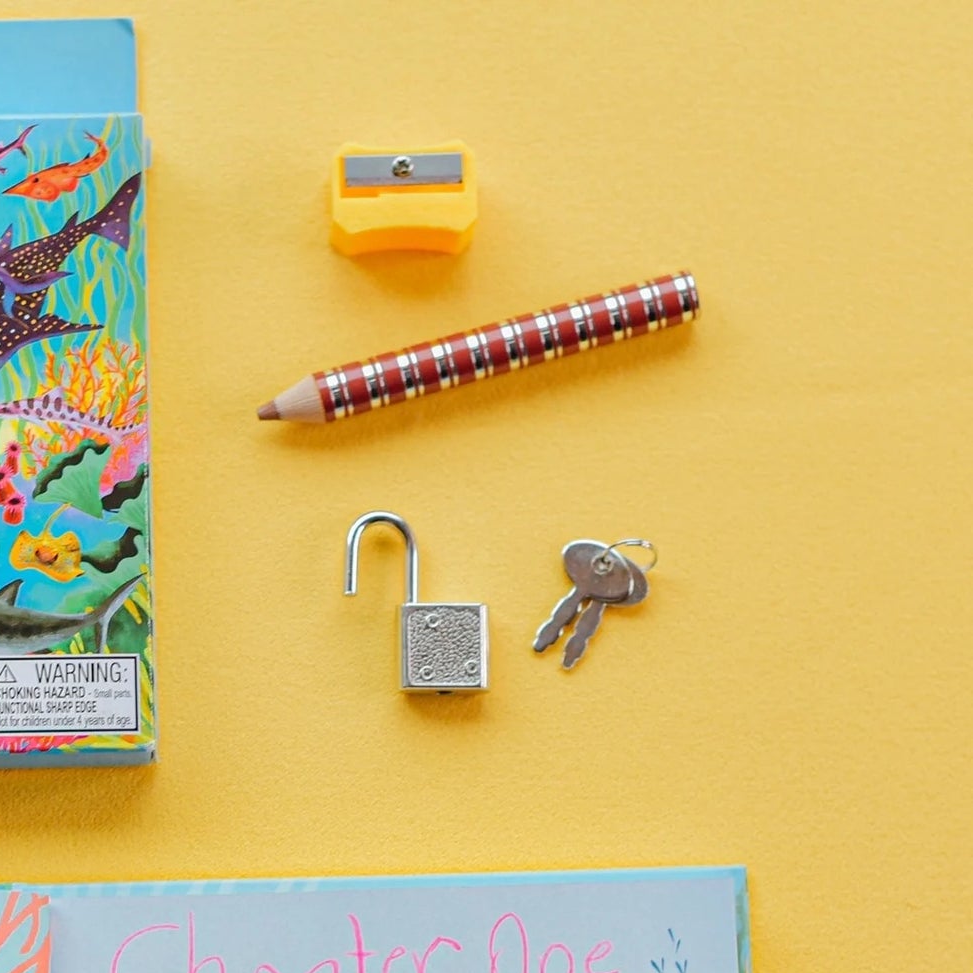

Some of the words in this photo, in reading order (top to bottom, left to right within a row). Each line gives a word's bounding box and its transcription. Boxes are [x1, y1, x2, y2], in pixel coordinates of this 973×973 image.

[35, 662, 128, 683] WARNING:
[43, 686, 85, 699] HAZARD
[47, 701, 74, 713] SHARP
[76, 701, 97, 713] EDGE
[10, 715, 20, 726] for
[22, 715, 51, 727] children
[53, 715, 75, 726] under
[84, 717, 105, 729] years
[107, 714, 115, 725] of
